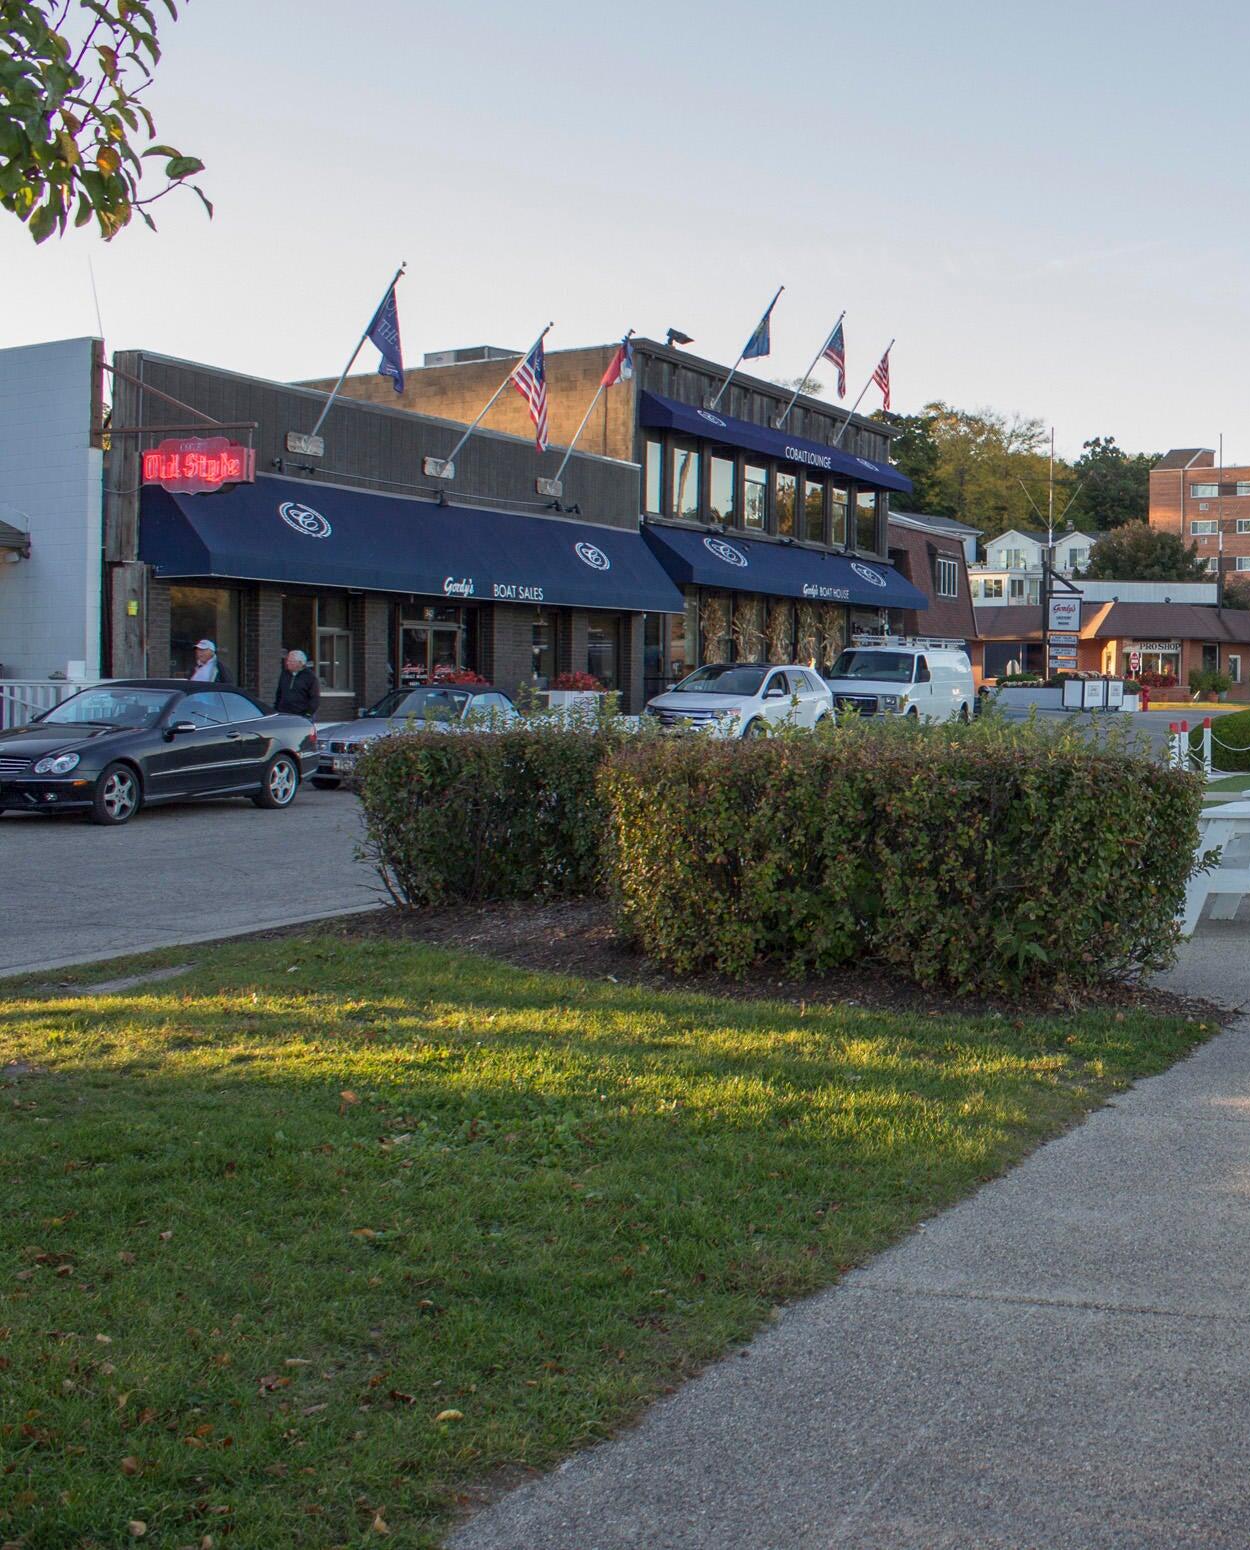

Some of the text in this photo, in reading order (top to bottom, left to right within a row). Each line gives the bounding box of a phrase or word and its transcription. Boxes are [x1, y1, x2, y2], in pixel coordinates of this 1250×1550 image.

[144, 452, 240, 482] Old Style
[785, 446, 832, 469] COBALT LOUNGE
[444, 576, 544, 601] Gordy's BOAT SALES
[819, 586, 833, 597] BOAT
[833, 588, 850, 599] HOUSE
[1139, 642, 1181, 651] PRO SHOP
